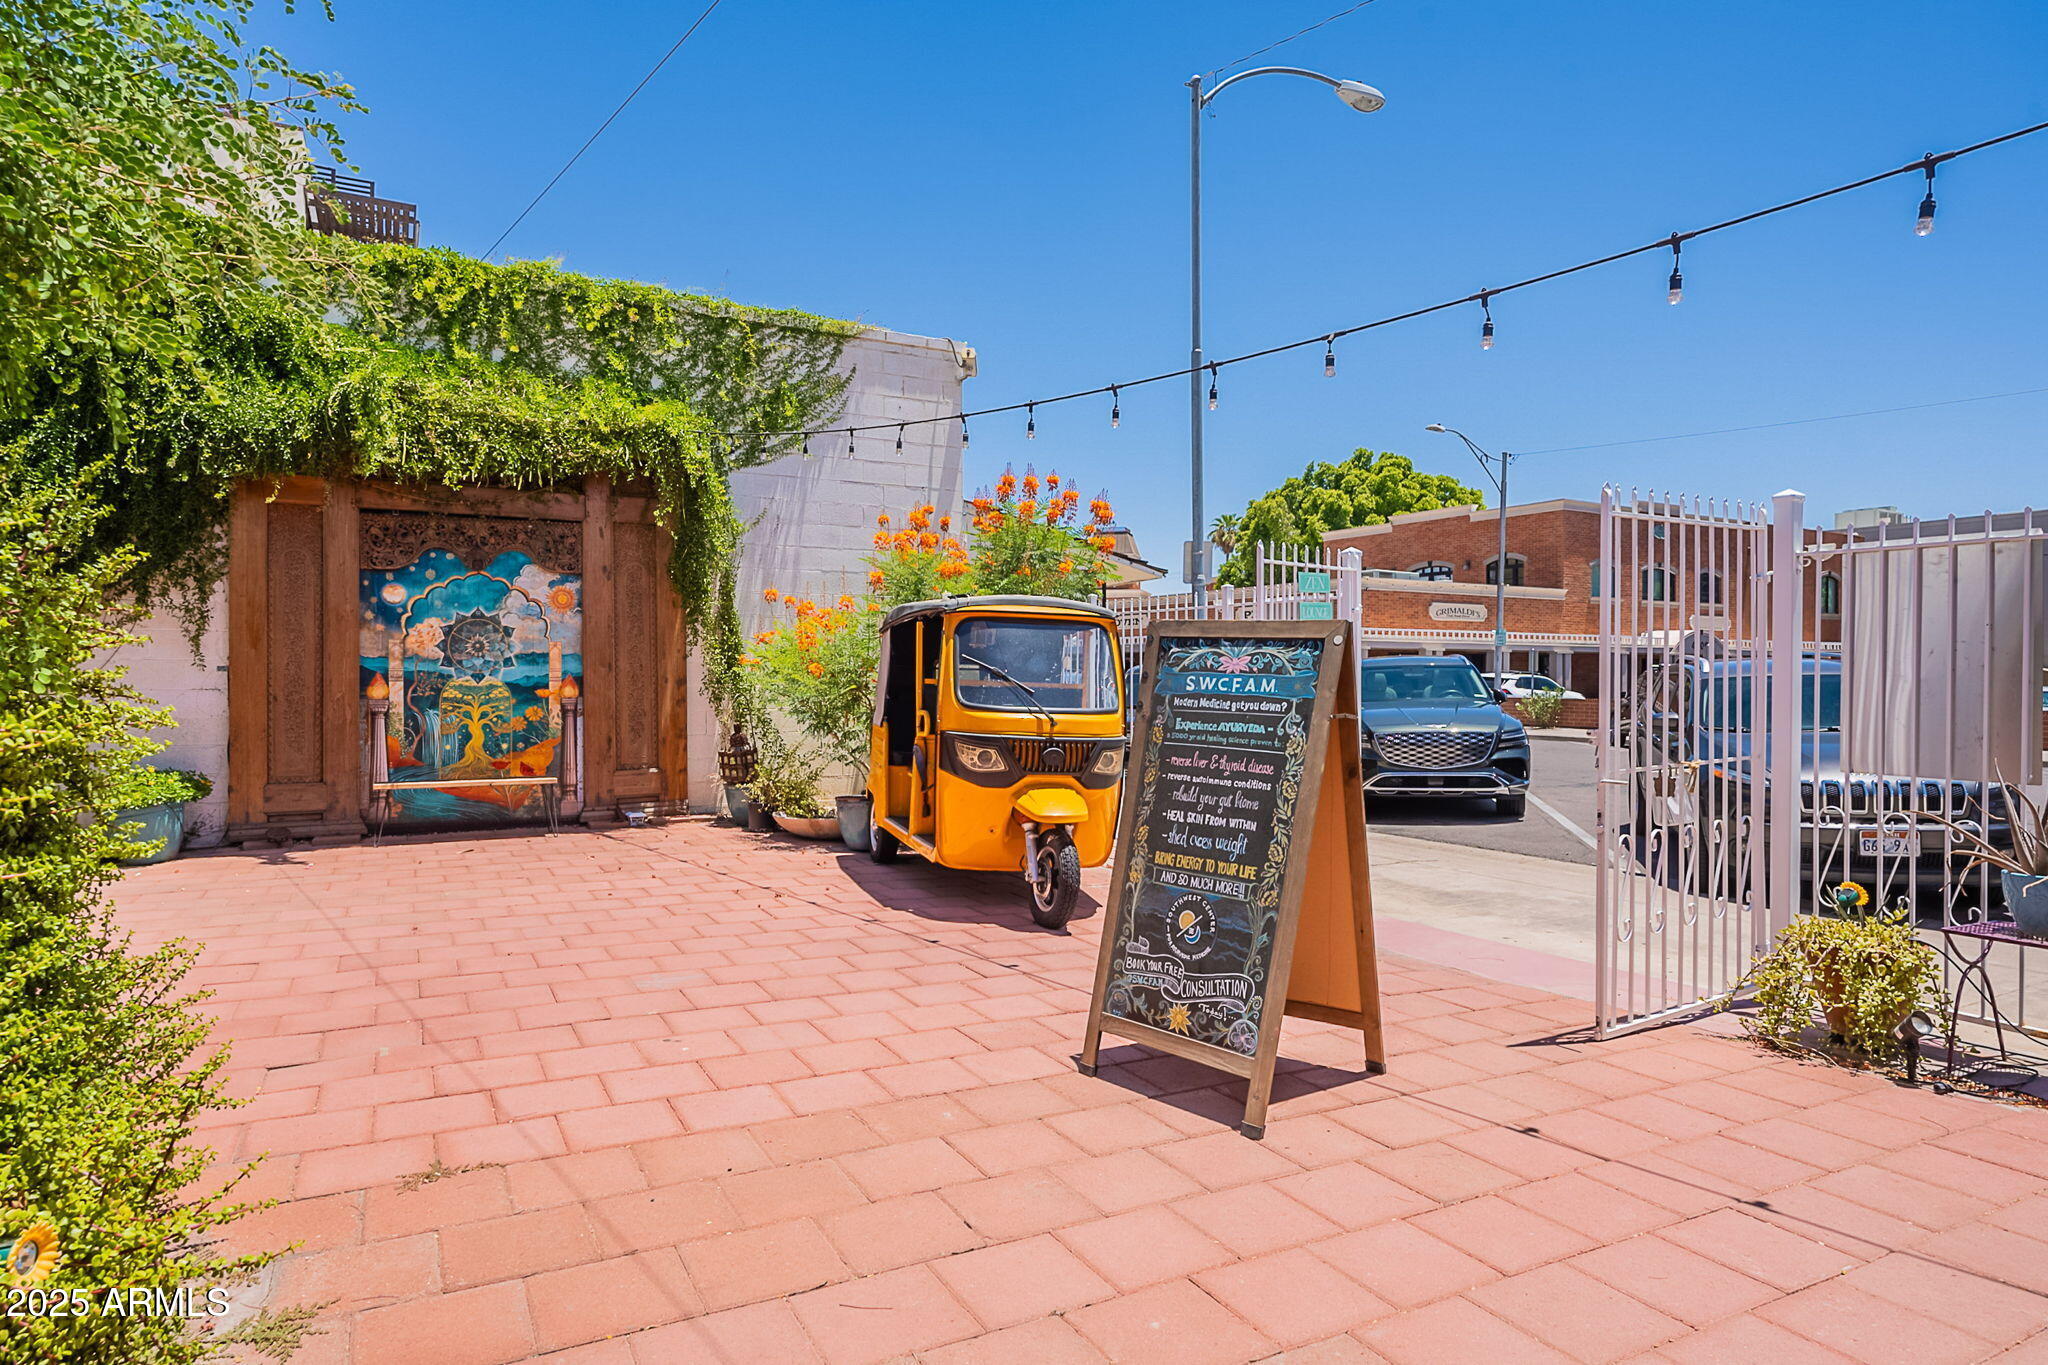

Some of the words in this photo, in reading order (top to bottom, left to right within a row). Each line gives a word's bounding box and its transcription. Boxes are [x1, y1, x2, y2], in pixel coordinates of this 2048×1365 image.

[1173, 696, 1198, 708] Modern
[1199, 697, 1230, 710] Medicine
[1260, 701, 1288, 712] down?
[1175, 717, 1217, 731] Experience
[1217, 722, 1266, 734] AYURVEDA
[1228, 736, 1249, 745] science
[1250, 739, 1272, 747] proven
[1210, 754, 1219, 770] &
[1219, 754, 1246, 776] thyroid
[1247, 759, 1274, 775] disease
[1233, 779, 1272, 791] conditions
[1186, 812, 1204, 825] SKIN
[1204, 813, 1226, 828] FROM
[1229, 818, 1257, 832] WITHIN
[1215, 832, 1248, 861] weight
[1154, 850, 1175, 867] BRING
[1175, 854, 1205, 871] ENERGY
[1205, 858, 1215, 873] TO
[1217, 860, 1238, 876] YOUR
[1238, 864, 1258, 880] LIFE
[1160, 870, 1177, 883] AND
[1177, 873, 1189, 885] SO
[1190, 876, 1214, 891] MUCH
[1166, 894, 1202, 923] SOUTHWEST
[1202, 900, 1216, 933] CENTER
[1126, 956, 1146, 971] BOOK
[1146, 959, 1163, 973] YOUR
[1164, 962, 1182, 978] FREE
[1181, 979, 1248, 999] CONSULTATION
